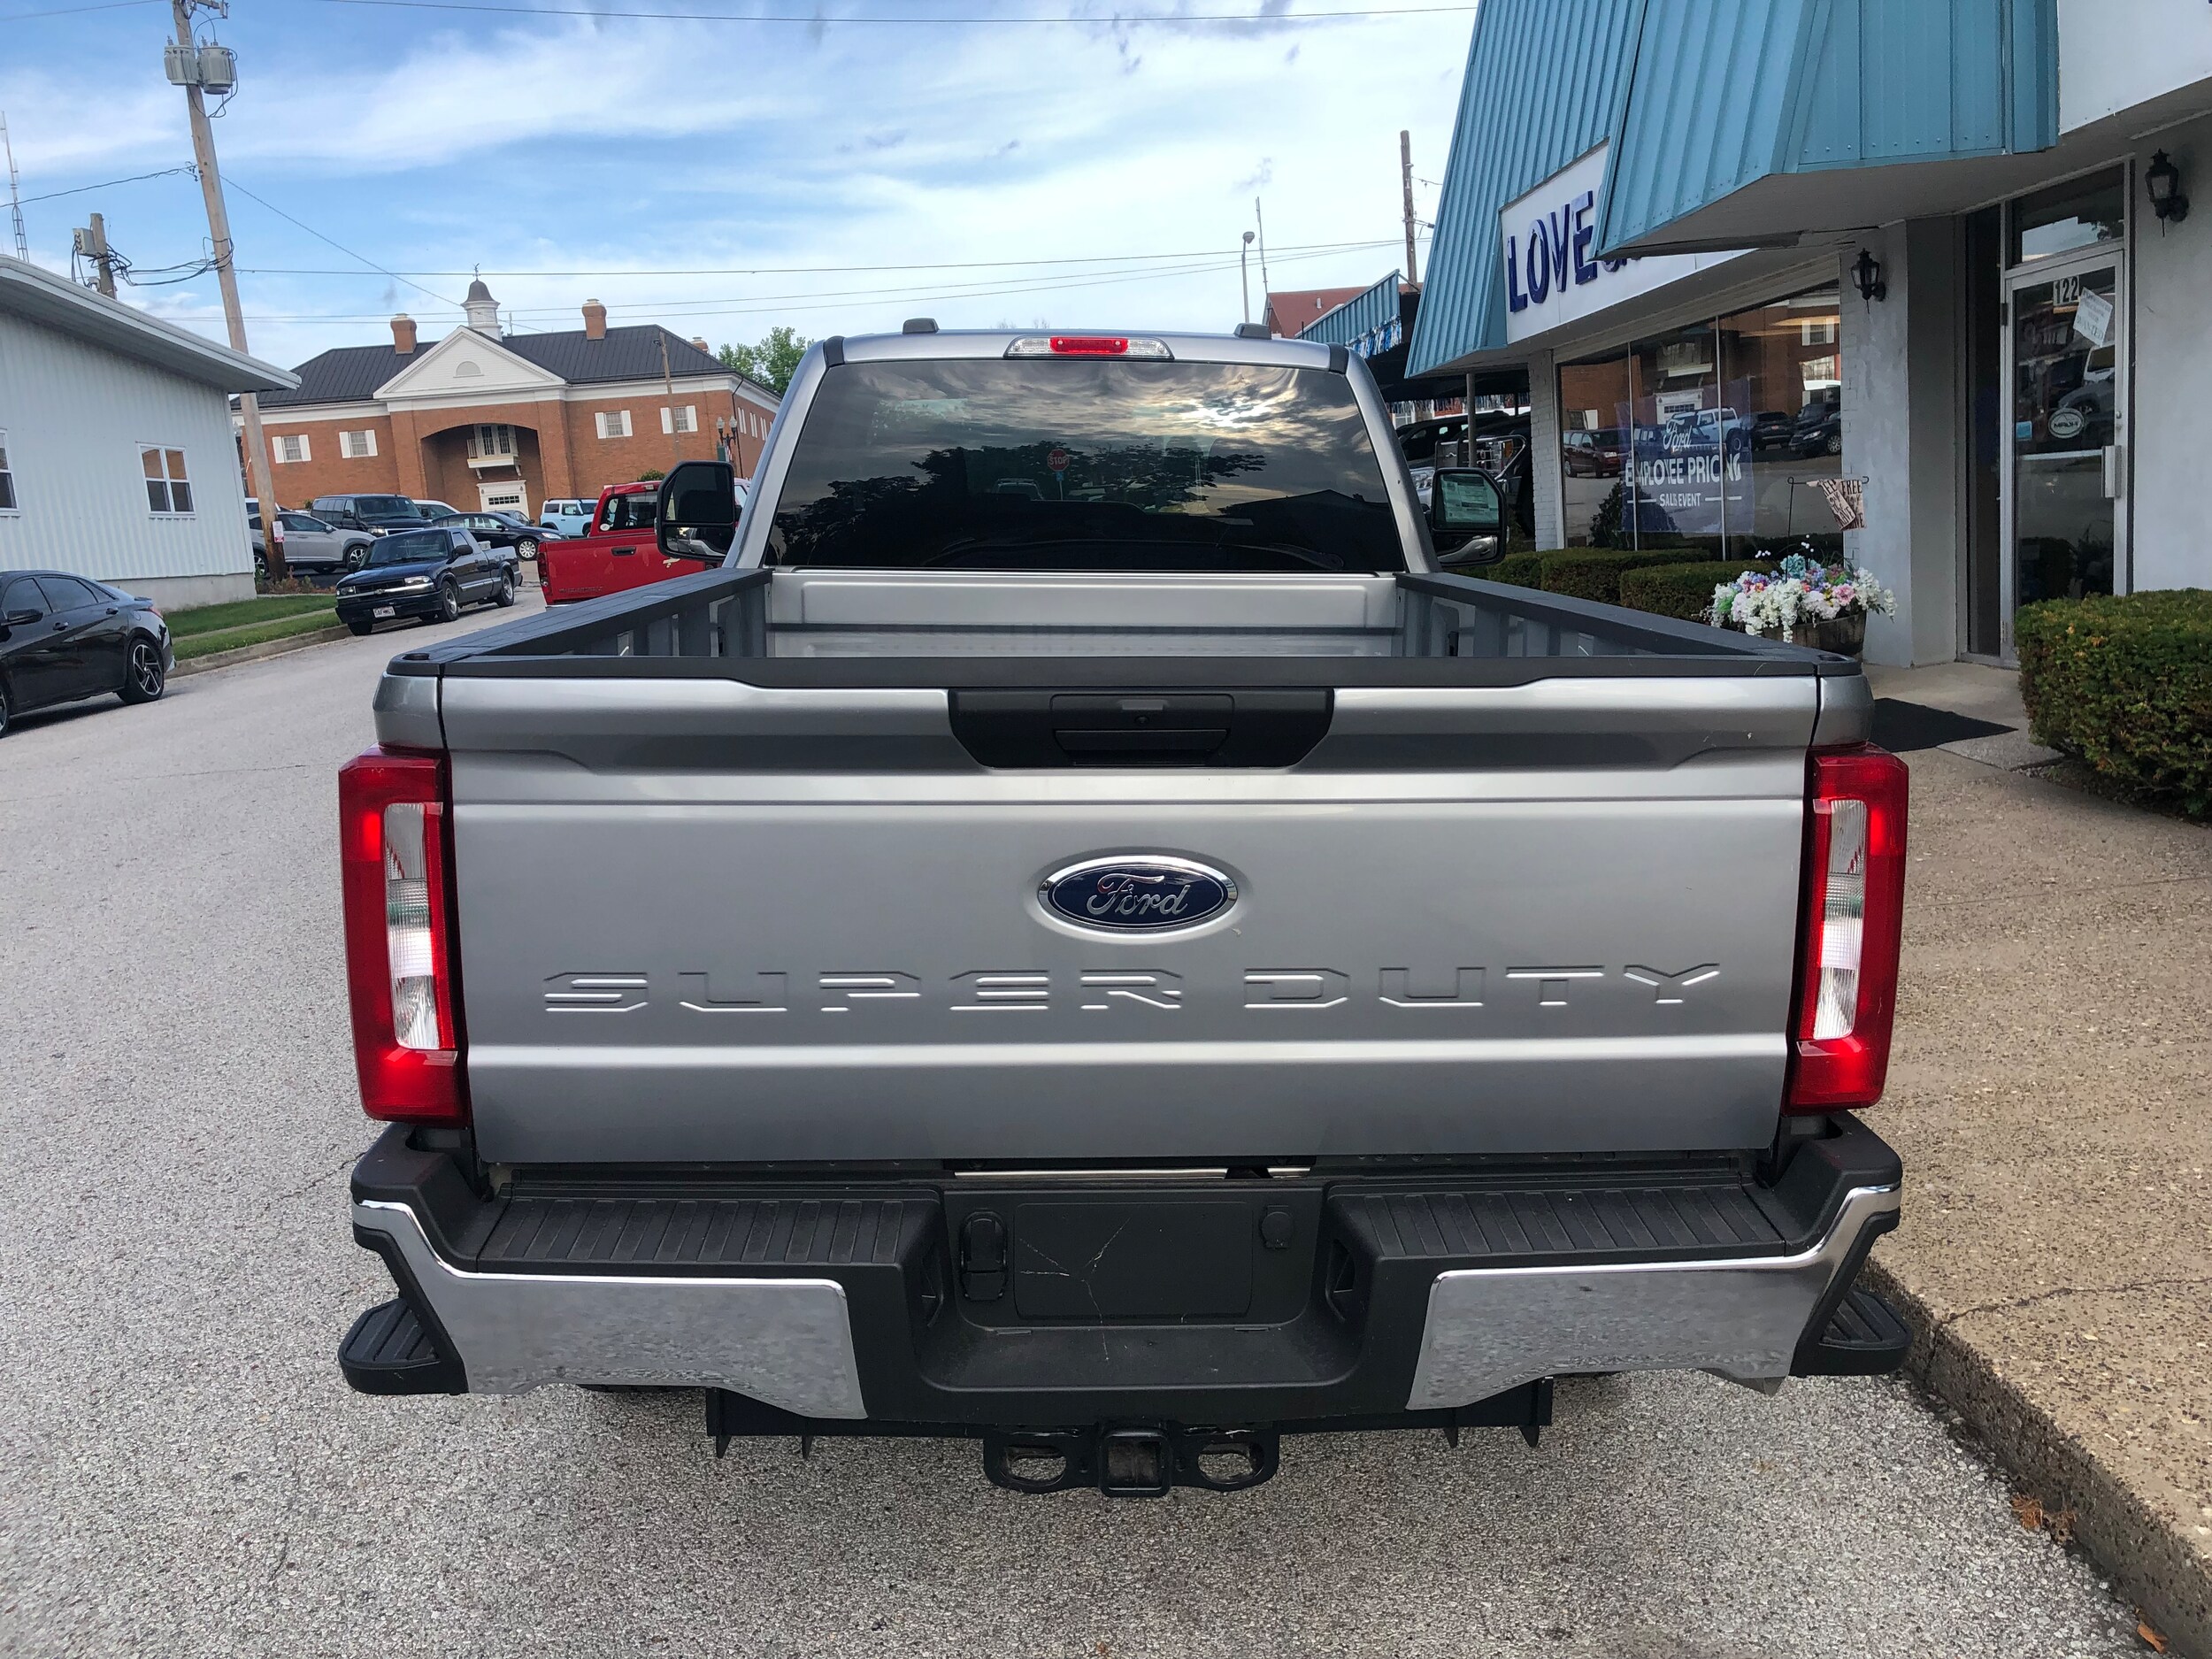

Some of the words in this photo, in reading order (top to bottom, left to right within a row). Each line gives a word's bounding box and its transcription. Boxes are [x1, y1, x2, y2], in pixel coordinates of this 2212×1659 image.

[1507, 190, 1627, 312] LOVE
[2055, 276, 2078, 303] 122
[1663, 419, 1693, 452] Ford
[1049, 456, 1067, 465] STOP
[1687, 452, 1742, 484] PRICNG
[1678, 492, 1701, 507] EVENT
[1840, 480, 1863, 495] FREE
[1087, 872, 1191, 915] Ford
[543, 968, 1183, 1012] SUPER
[1244, 963, 1721, 1008] DUTY
